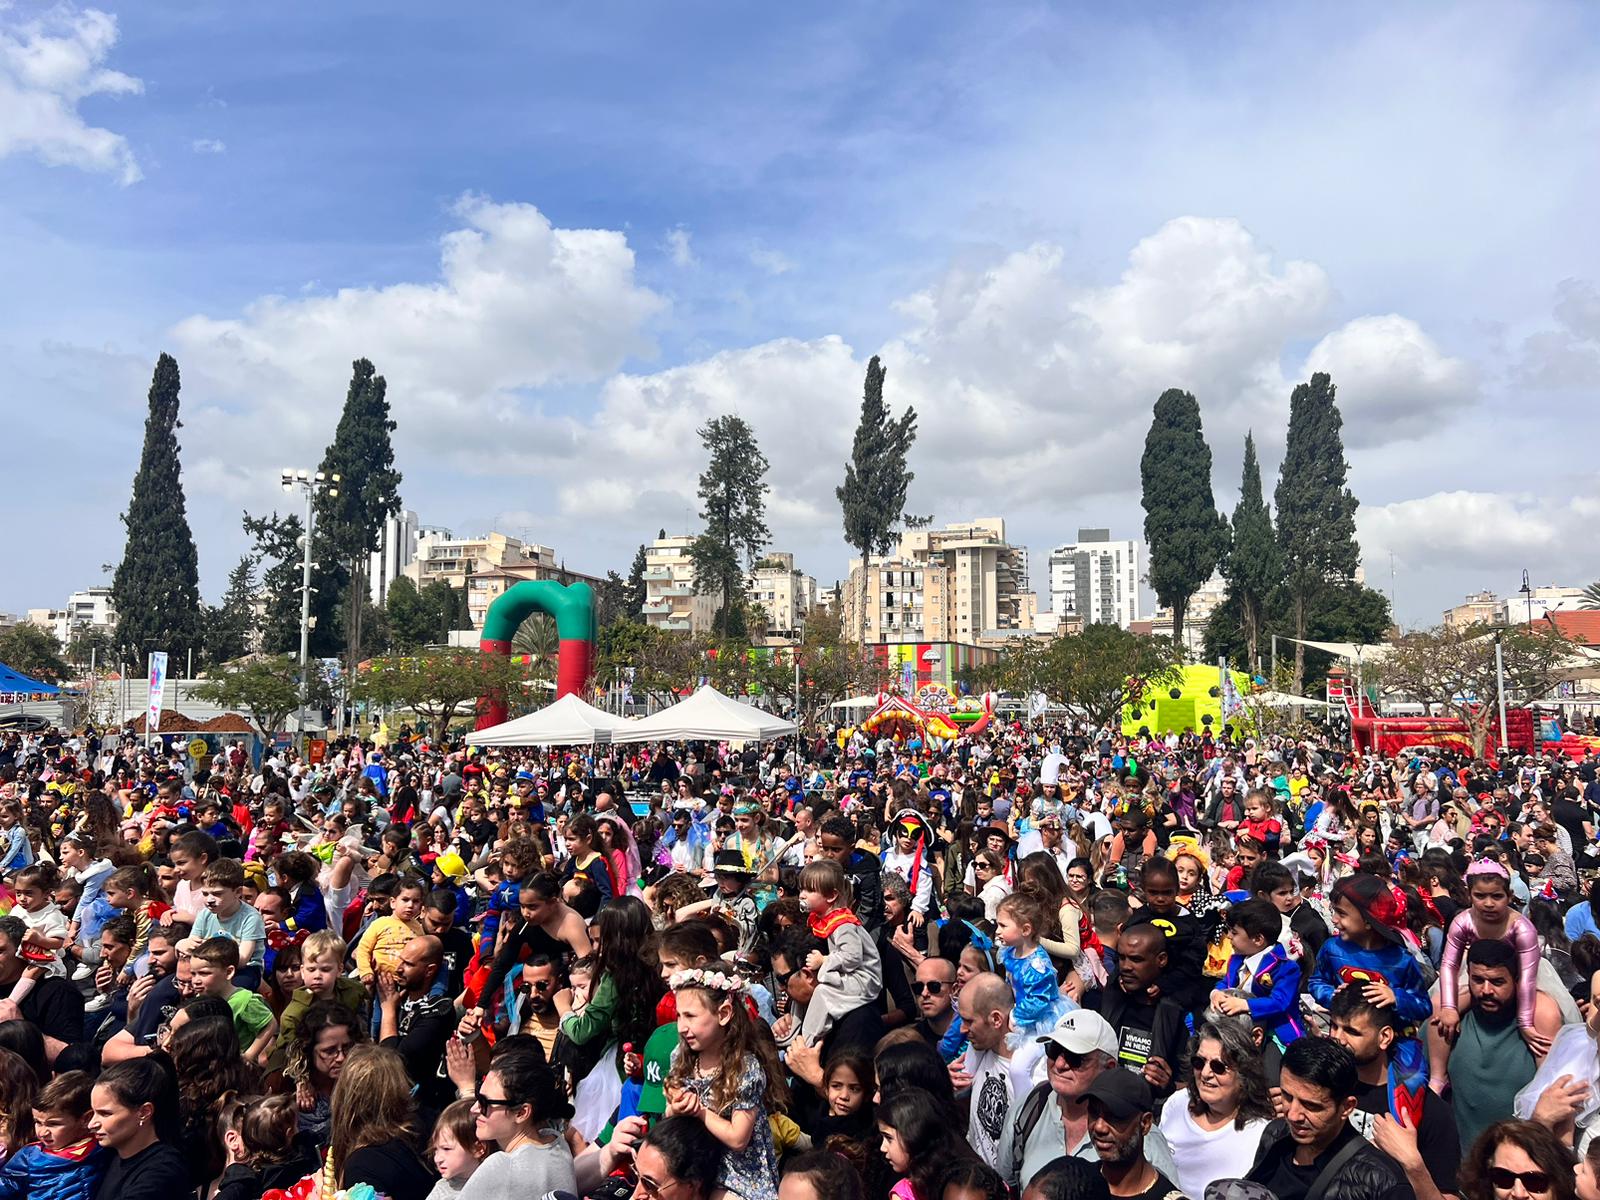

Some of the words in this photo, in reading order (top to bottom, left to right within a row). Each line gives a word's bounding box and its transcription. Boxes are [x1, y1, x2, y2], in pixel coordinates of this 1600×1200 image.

[1125, 1040, 1132, 1048] IN
[1126, 1034, 1152, 1046] VIVIAMO
[647, 1060, 661, 1082] NY
